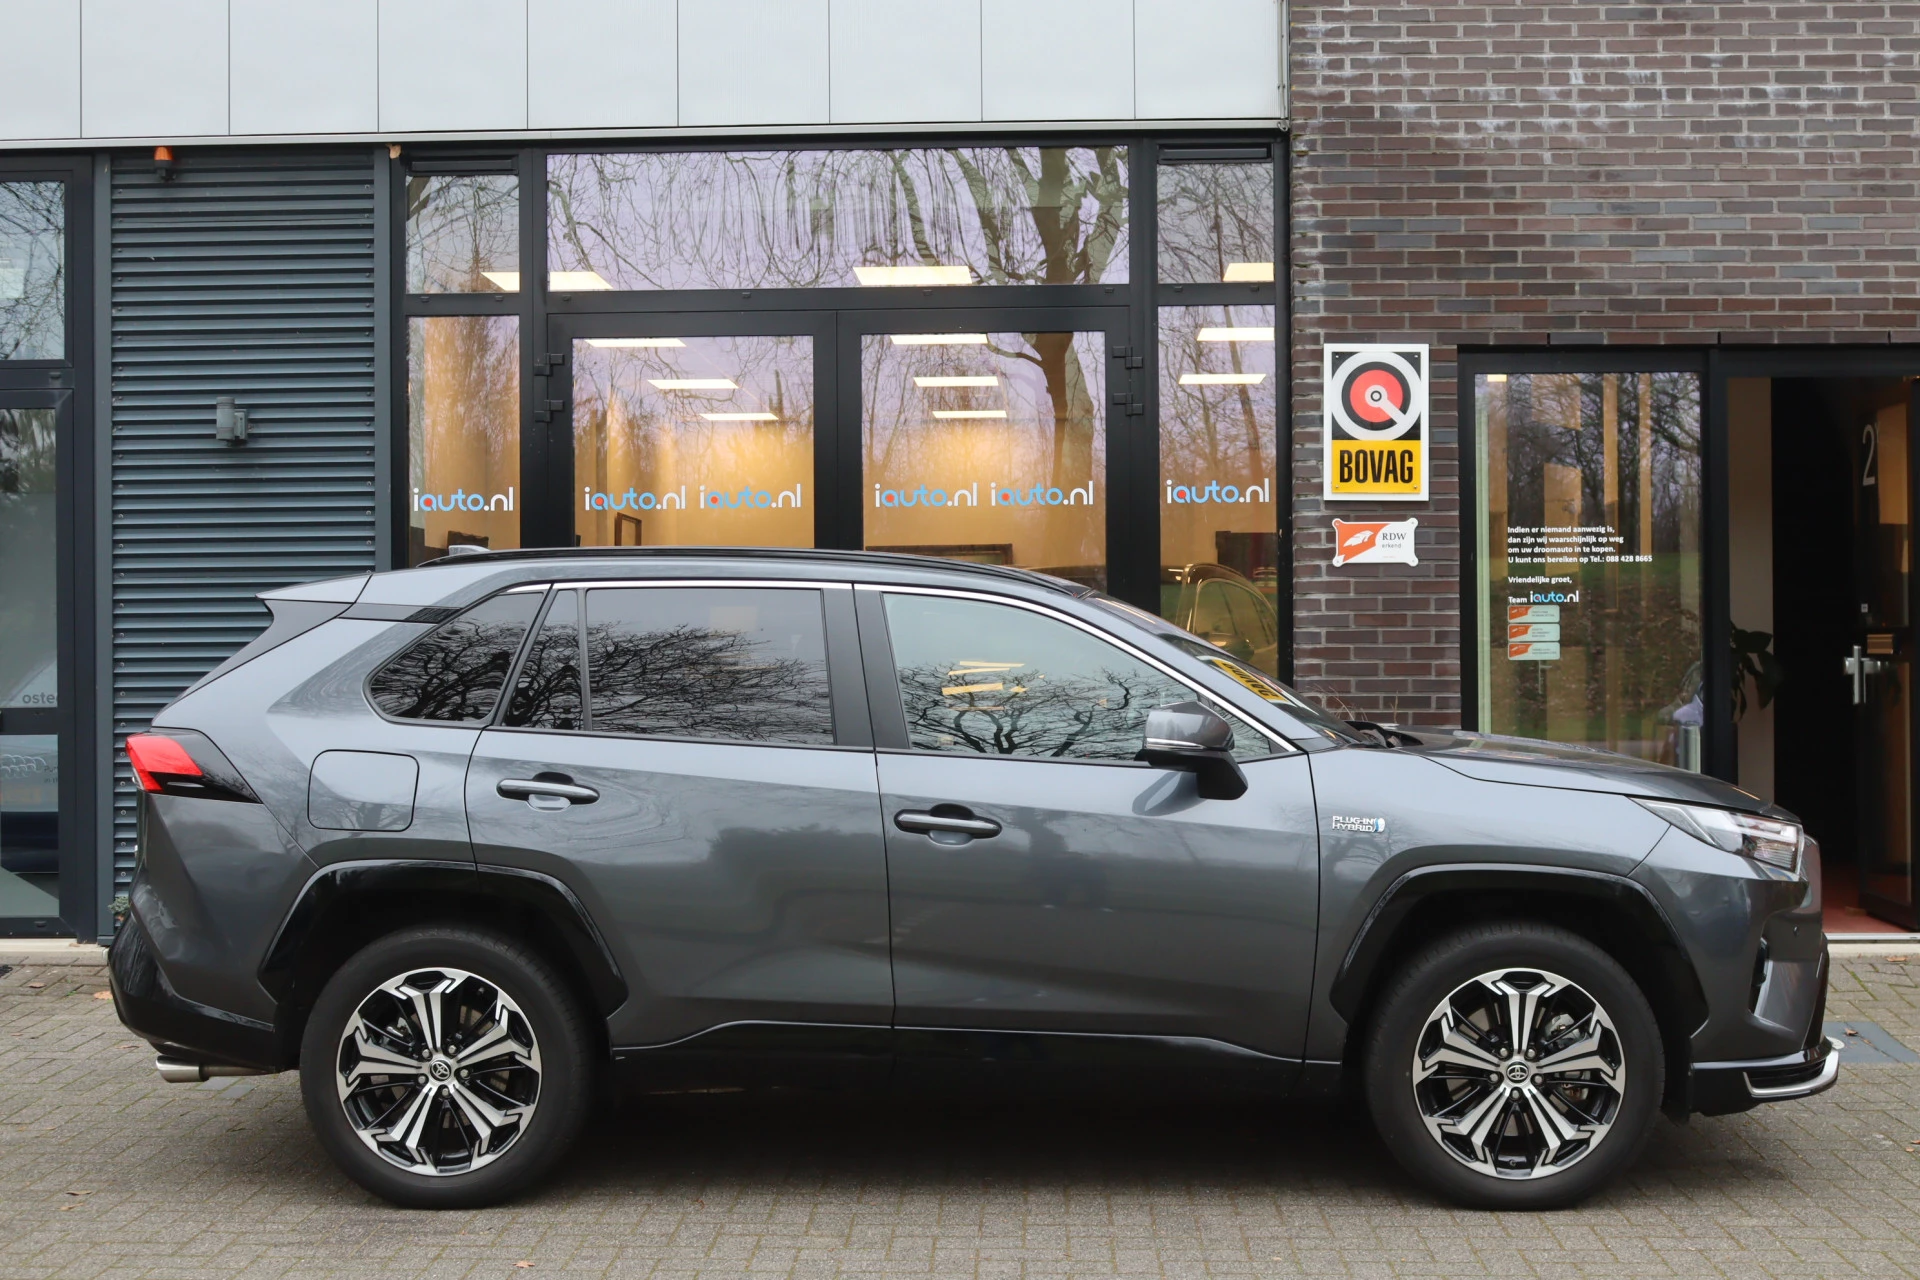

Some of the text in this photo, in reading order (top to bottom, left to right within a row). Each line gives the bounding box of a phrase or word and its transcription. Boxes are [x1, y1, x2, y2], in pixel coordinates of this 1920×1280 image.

[1339, 449, 1413, 483] BOVAG
[413, 487, 513, 512] iauto.nl
[585, 485, 685, 510] iauto.nl
[700, 484, 800, 509] iauto.nl
[875, 482, 977, 507] iauto.nl
[991, 481, 1093, 506] iauto.nl
[1166, 478, 1269, 504] iauto.nl
[1382, 533, 1407, 541] RDW
[1523, 536, 1535, 544] zijn
[1537, 536, 1547, 544] wij
[1508, 576, 1572, 584] Vriendelijke groet,
[1530, 590, 1579, 603] iauto.nl
[22, 692, 58, 704] oste
[1332, 815, 1374, 825] PLUG-IN
[1332, 823, 1374, 832] HYBRID
